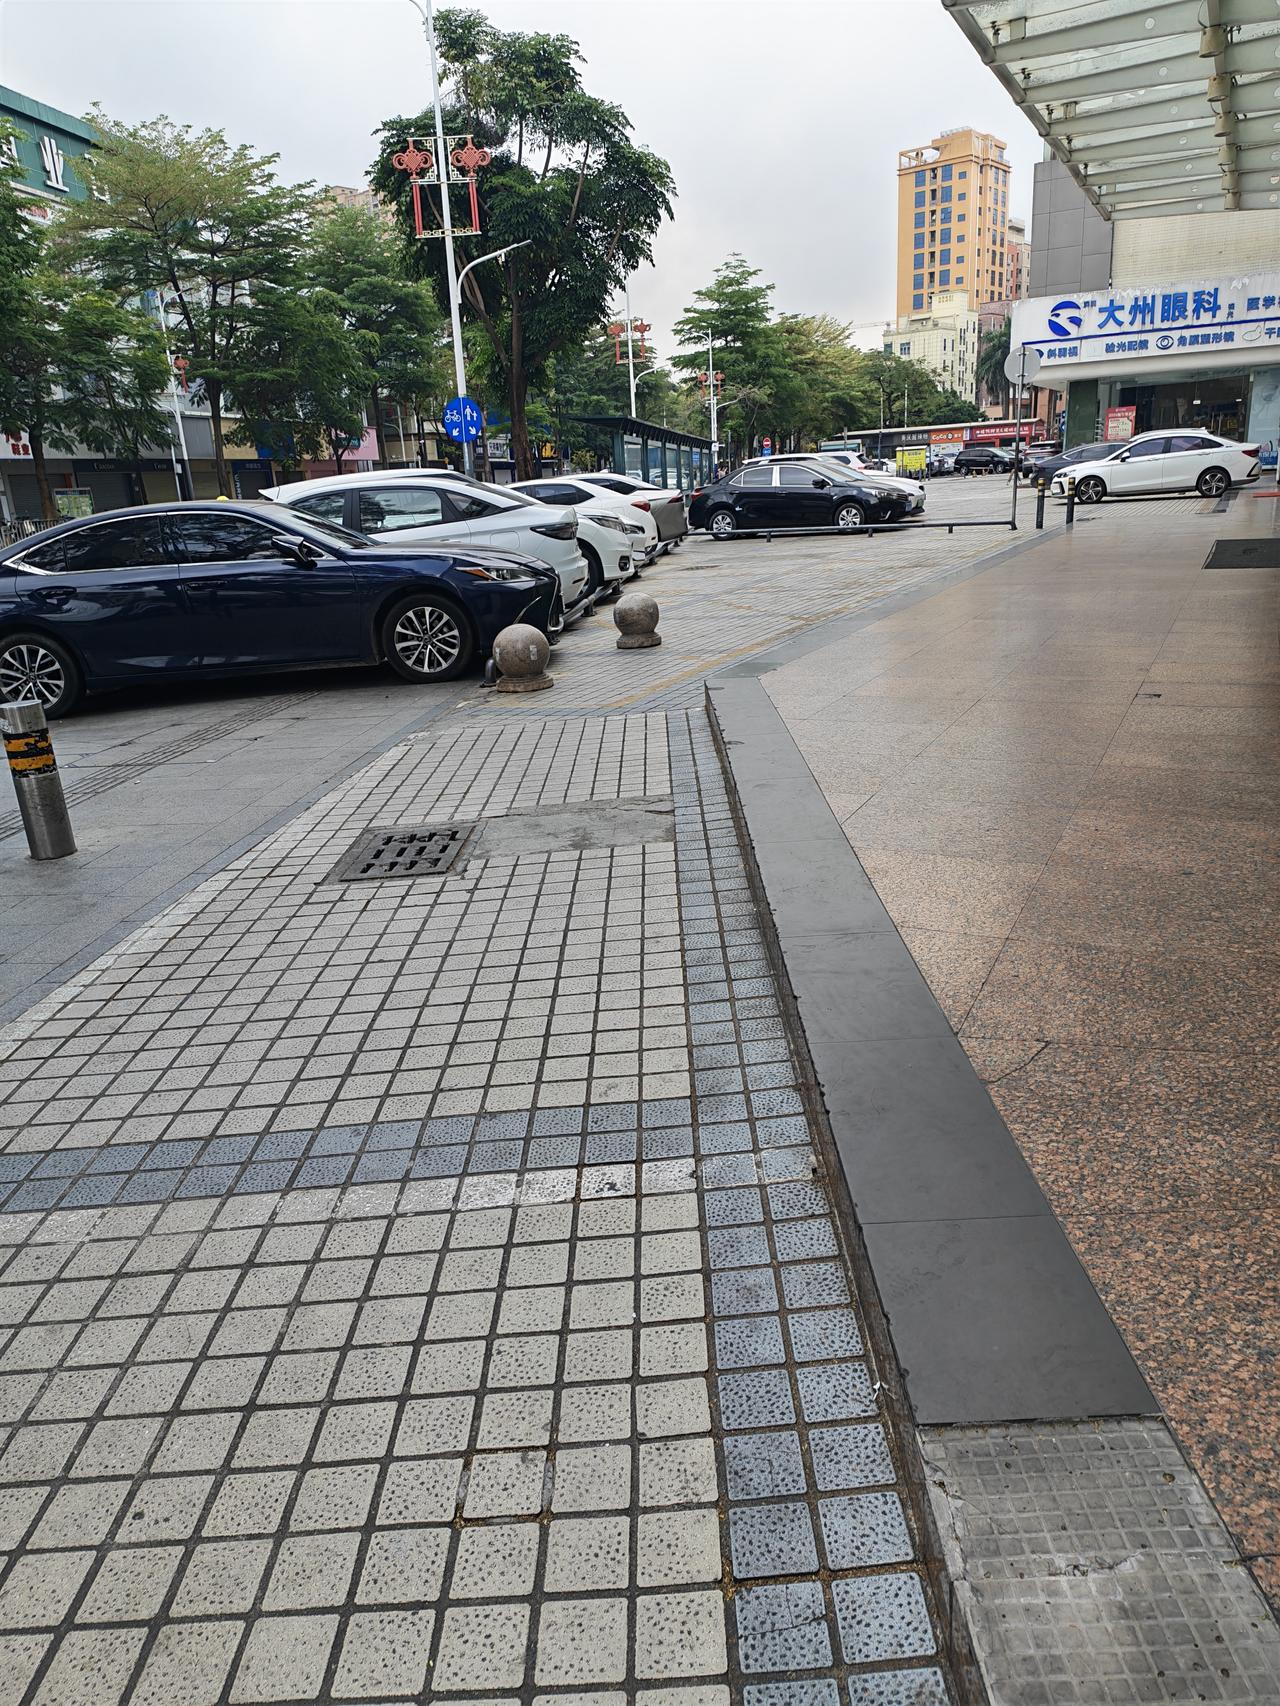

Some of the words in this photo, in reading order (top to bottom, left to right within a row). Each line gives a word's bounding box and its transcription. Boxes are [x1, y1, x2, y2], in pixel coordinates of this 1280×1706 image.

[1097, 288, 1222, 329] 大州眼科
[1247, 296, 1280, 312] 医学
